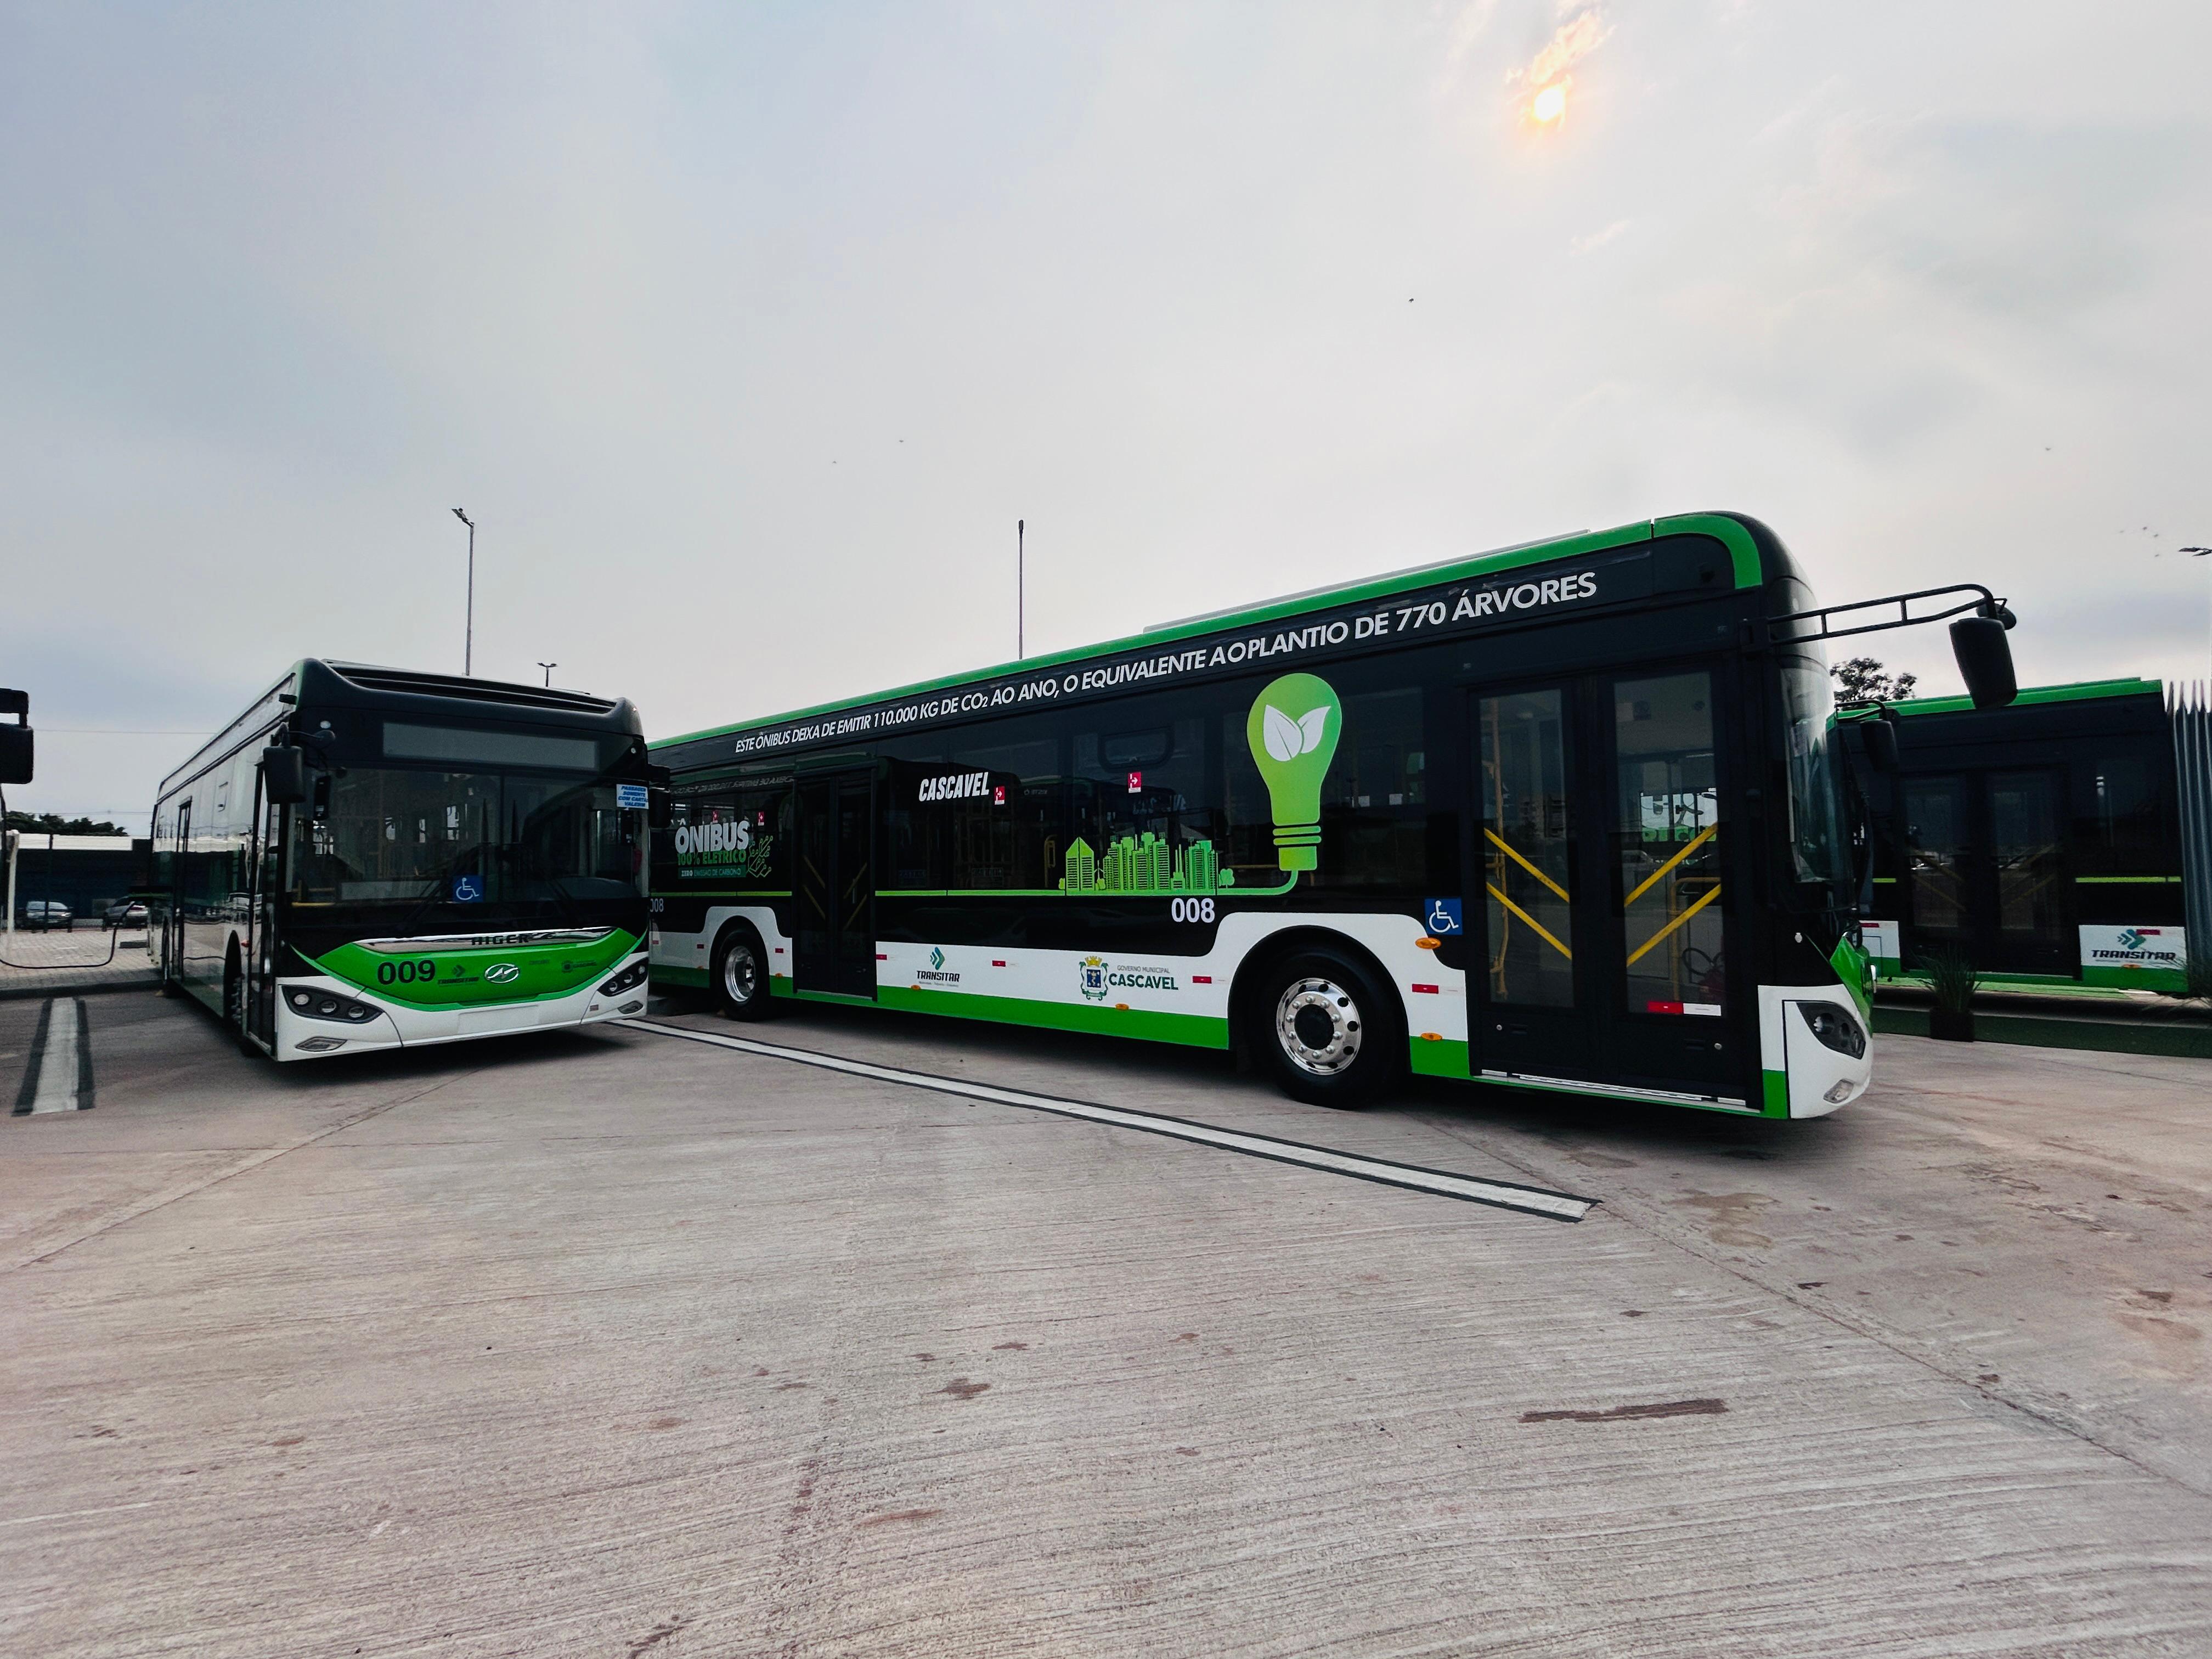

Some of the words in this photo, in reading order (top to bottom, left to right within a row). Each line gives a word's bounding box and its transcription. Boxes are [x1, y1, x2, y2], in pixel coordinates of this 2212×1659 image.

[735, 737, 756, 753] ESTE
[755, 730, 791, 749] ÔNIBUS
[791, 725, 820, 743] DEIXA
[821, 721, 836, 737] DE
[837, 714, 871, 735] EMITIR
[874, 706, 918, 727] 110.000
[919, 701, 939, 719] KG
[940, 697, 959, 715] DE
[990, 687, 1014, 706] AO
[1018, 679, 1059, 701] ANO,
[1063, 675, 1079, 693] O
[1081, 649, 1206, 690] EQUIVALENTE
[1355, 612, 1389, 640] DE
[1396, 602, 1446, 631] 770
[1452, 572, 1597, 622] ÁRVORES
[918, 772, 989, 802] CASCAVEL
[675, 818, 749, 854] ÔNIBUS
[678, 853, 700, 866] 100%
[1171, 898, 1215, 923] 008
[471, 934, 529, 945] HIGER
[2091, 950, 2176, 961] TRANSITAR
[377, 959, 436, 985] 009
[917, 970, 960, 982] TRANSITAR
[1109, 973, 1178, 990] CASCAVEL
